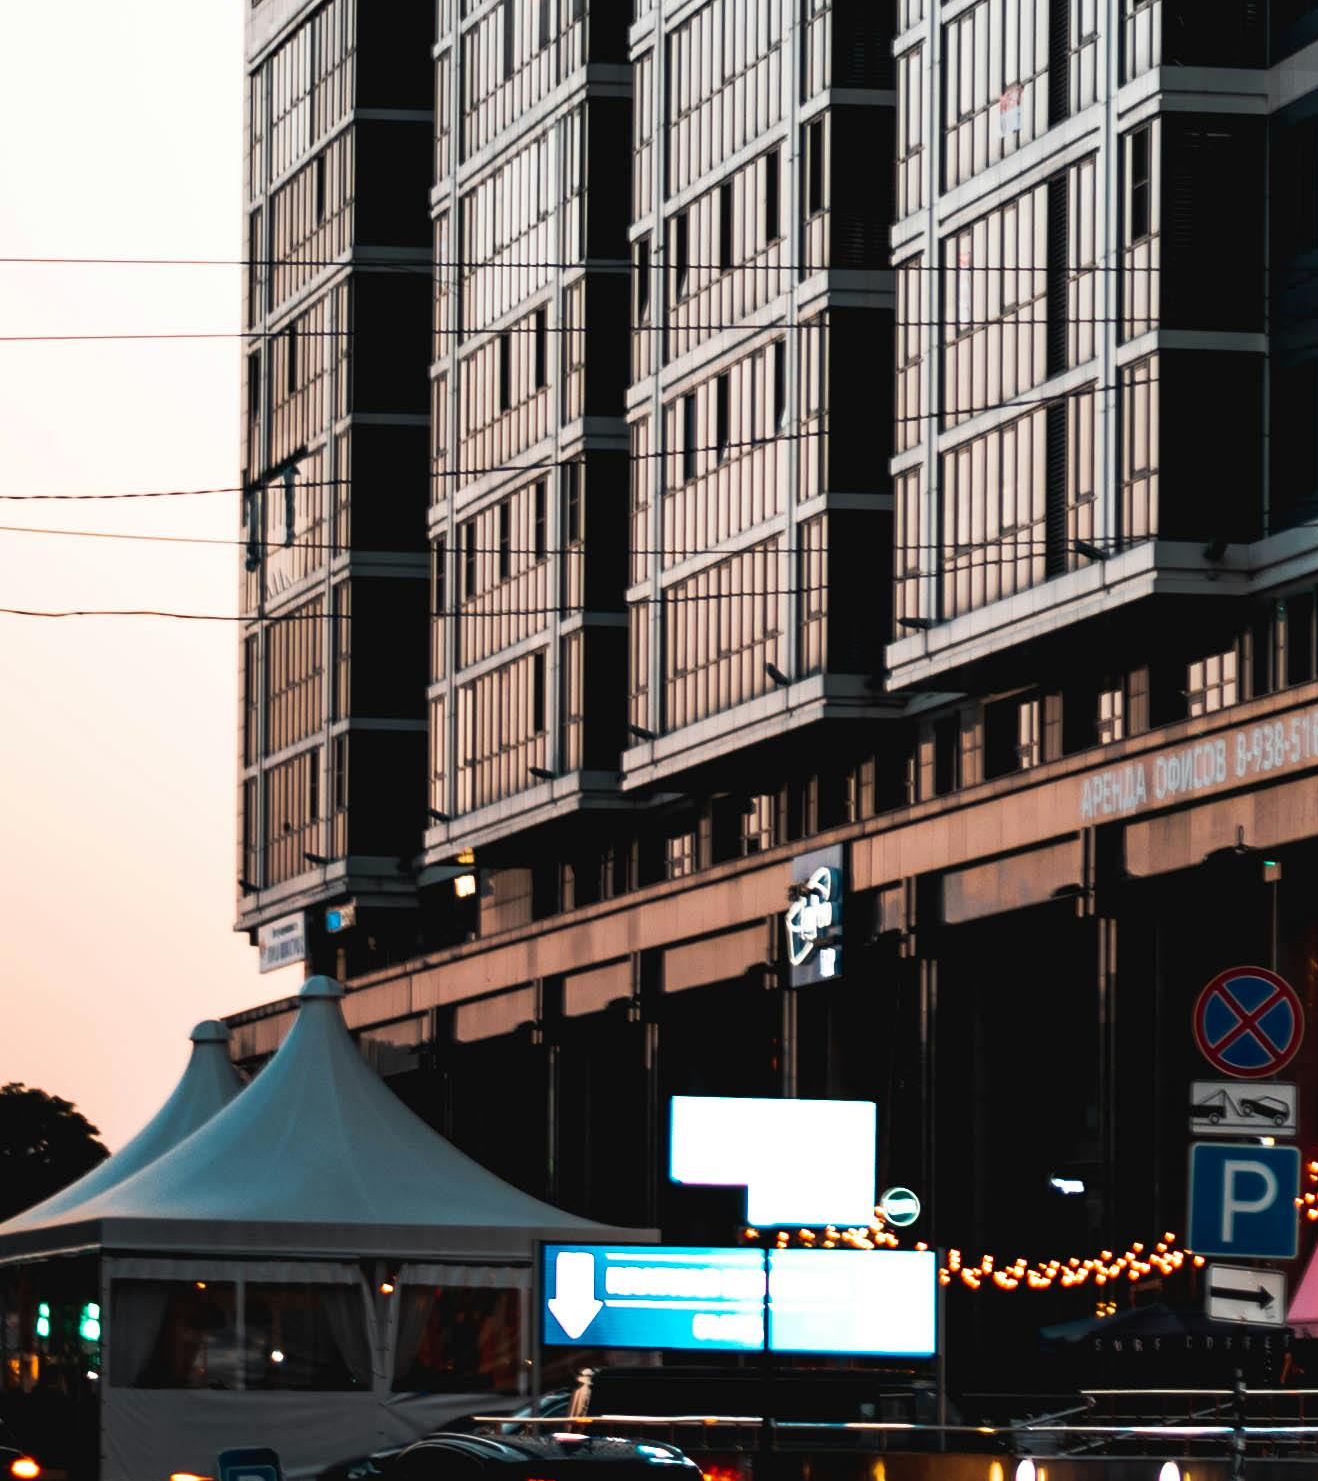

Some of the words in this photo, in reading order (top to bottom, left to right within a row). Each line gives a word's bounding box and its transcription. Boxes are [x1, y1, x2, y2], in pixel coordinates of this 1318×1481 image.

[1080, 762, 1147, 821] АРЕНДА
[1153, 738, 1227, 800] ОФИСОВ
[1220, 1159, 1280, 1244] P
